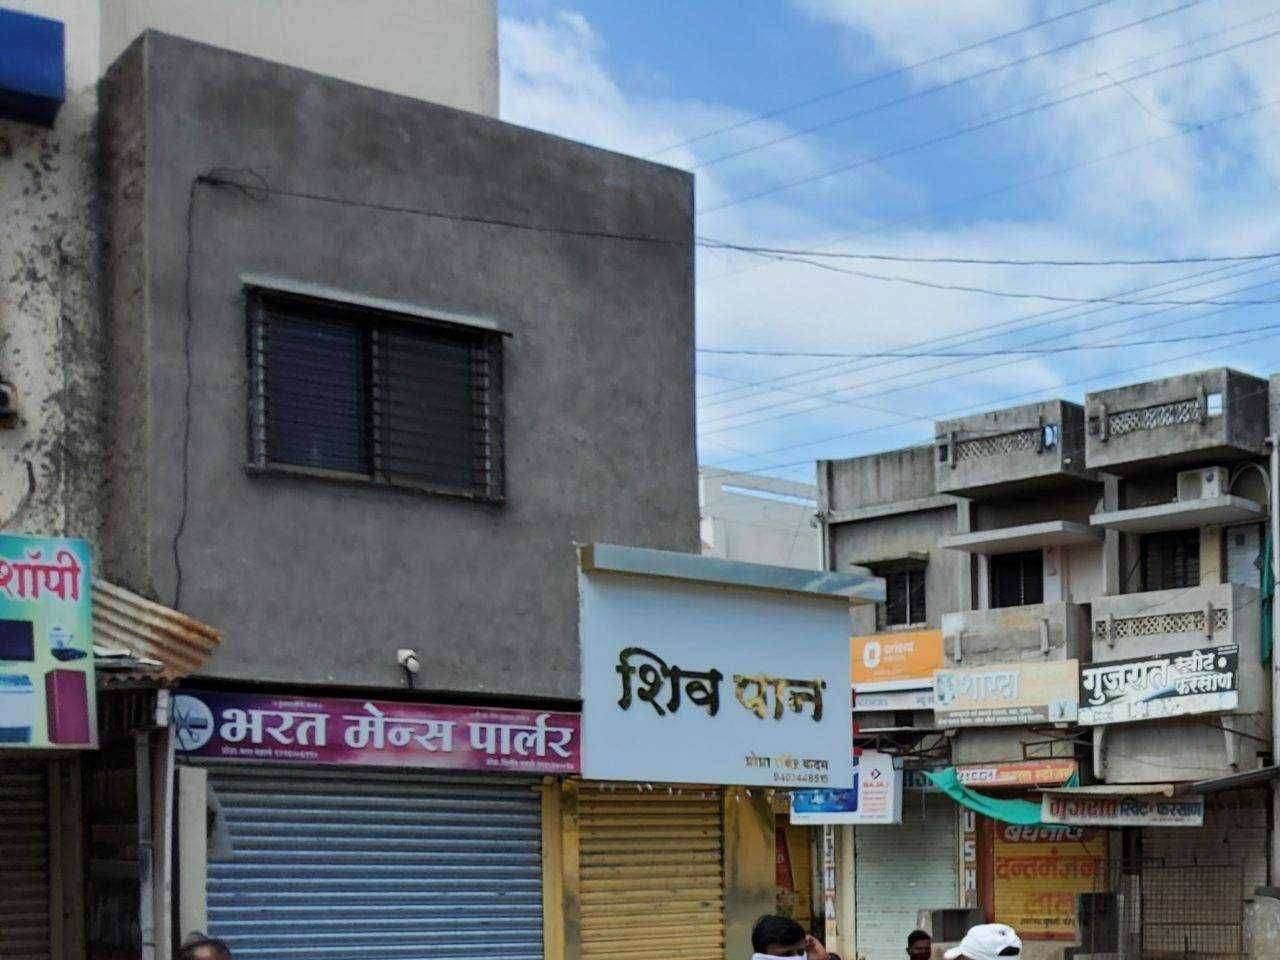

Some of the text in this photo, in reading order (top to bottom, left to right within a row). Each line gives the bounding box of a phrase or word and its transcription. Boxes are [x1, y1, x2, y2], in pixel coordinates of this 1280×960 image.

[615, 646, 723, 717] शिव
[219, 702, 575, 759] भरत मेन्स पार्लर
